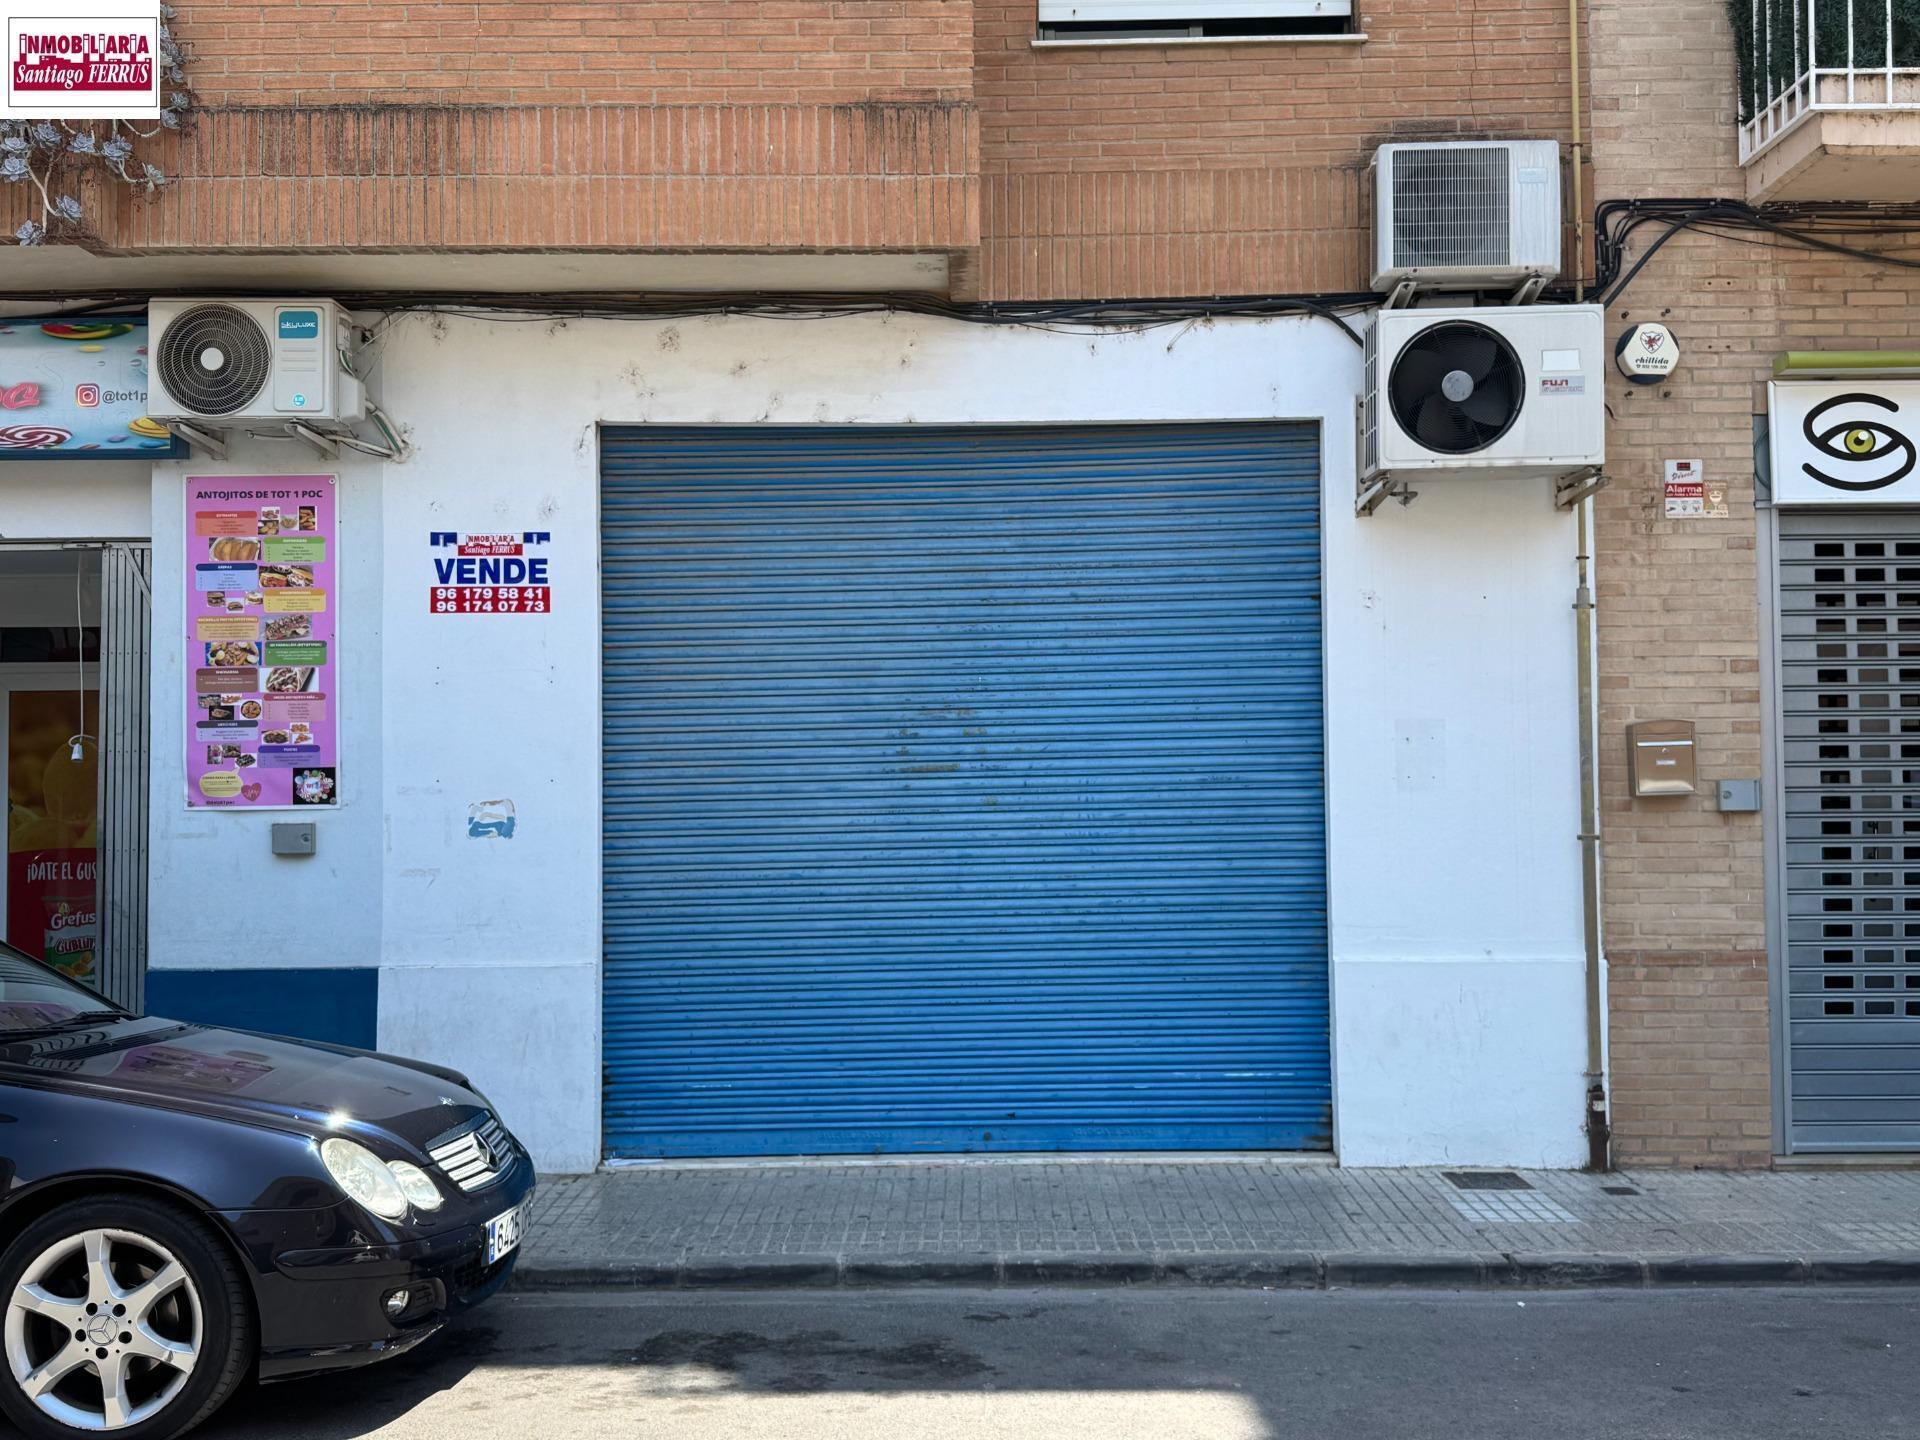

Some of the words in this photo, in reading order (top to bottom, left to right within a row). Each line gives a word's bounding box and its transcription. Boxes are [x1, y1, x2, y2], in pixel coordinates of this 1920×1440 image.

[1666, 484, 1703, 493] Alarma
[196, 490, 253, 501] ANTOJITOS
[255, 491, 269, 499] DE
[270, 490, 291, 499] TOT
[294, 490, 299, 499] 1
[301, 490, 323, 498] POC
[464, 546, 490, 555] Santiago
[491, 546, 515, 554] FERRUS
[434, 558, 548, 584] VENDE
[436, 588, 457, 599] 96
[463, 588, 493, 599] 179
[498, 588, 519, 599] 58
[523, 588, 543, 599] 41
[436, 601, 457, 612] 96
[463, 601, 493, 612] 174
[498, 601, 518, 612] 07
[524, 601, 544, 612] 73
[27, 861, 58, 884] ¡DATE
[61, 862, 73, 880] EL
[51, 911, 96, 929] Grefus
[497, 1211, 520, 1253] 6425
